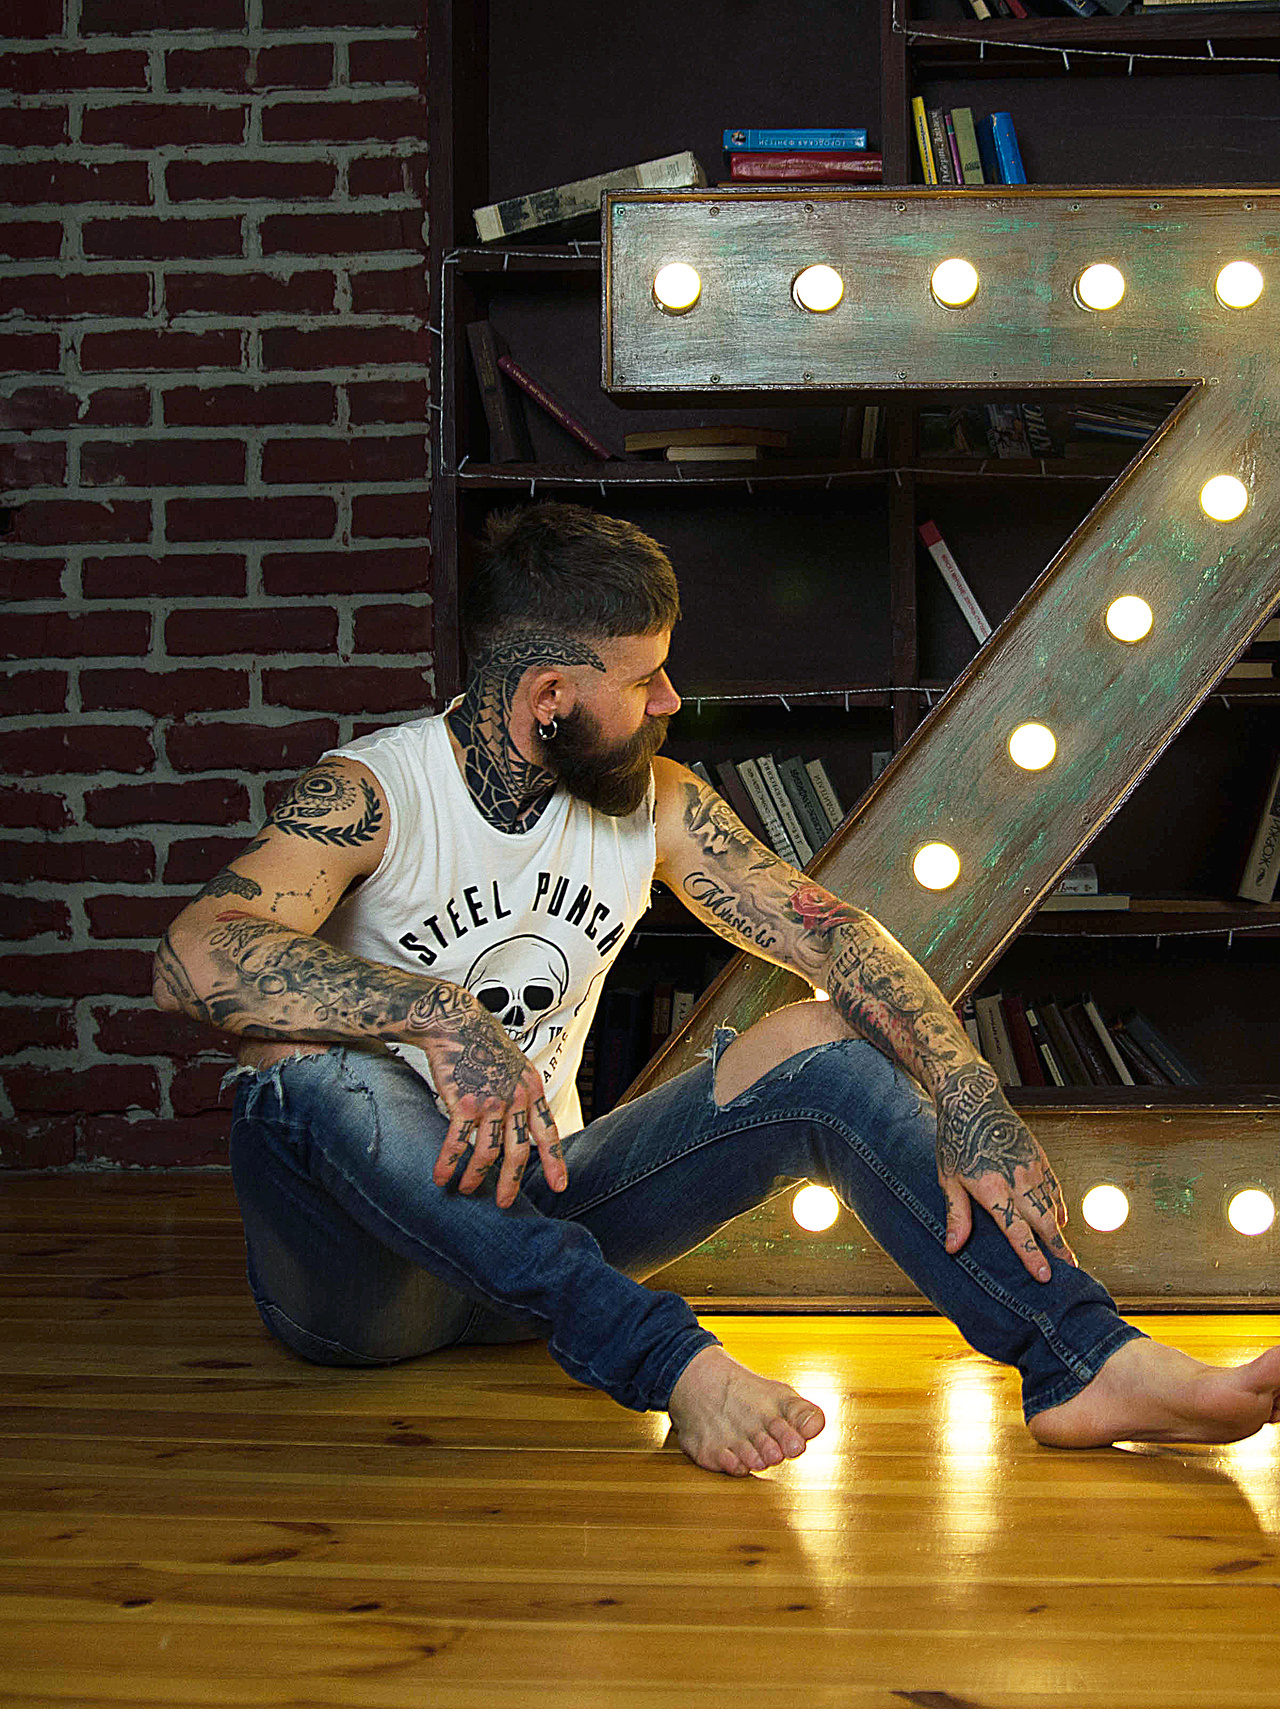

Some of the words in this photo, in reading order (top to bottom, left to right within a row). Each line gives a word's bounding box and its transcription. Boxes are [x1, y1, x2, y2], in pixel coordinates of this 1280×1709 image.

[398, 880, 512, 967] STEEL
[532, 872, 627, 957] PUNCH
[683, 872, 752, 938] Music
